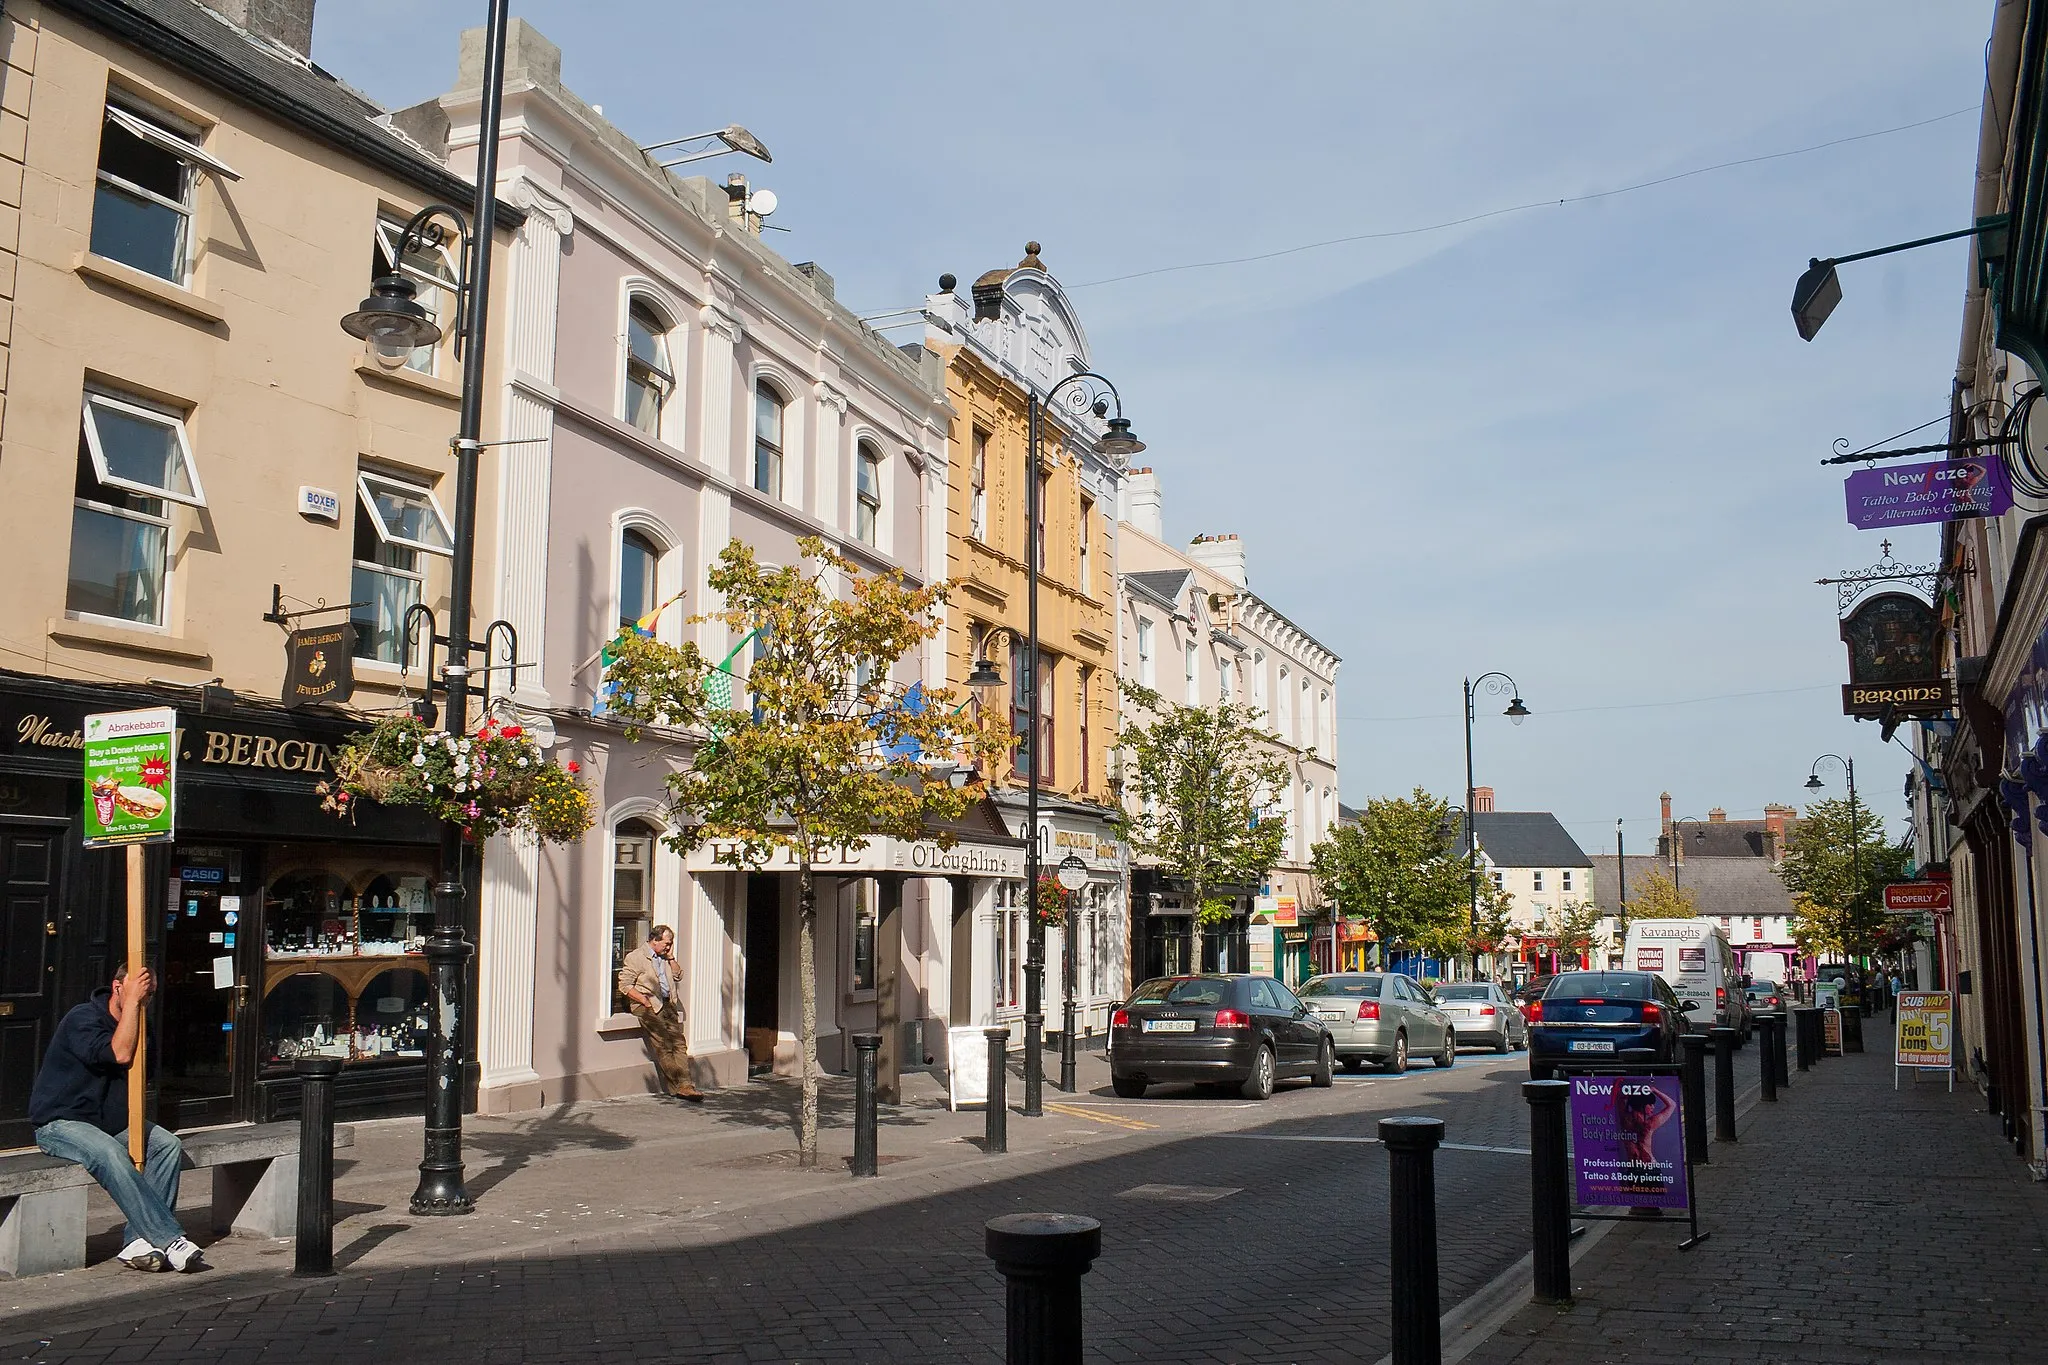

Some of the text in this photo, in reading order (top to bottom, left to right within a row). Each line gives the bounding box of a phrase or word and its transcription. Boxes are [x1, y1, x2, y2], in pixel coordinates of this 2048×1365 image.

[307, 492, 336, 509] BOXER
[1861, 485, 1996, 507] Tattoo Body Piercing
[1879, 506, 1941, 520] Alternative
[1943, 501, 1992, 514] Clothing
[297, 636, 317, 648] JAMES
[296, 680, 337, 696] JEWELLER
[17, 714, 86, 750] Watch
[107, 720, 166, 733] Abrakebabra
[89, 749, 104, 757] Buy
[134, 744, 158, 752] Kebab
[89, 756, 139, 767] Medium Drink
[125, 765, 139, 773] only
[912, 844, 1007, 874] O'Loughlin's
[182, 869, 220, 879] CASIO
[1890, 887, 1932, 896] PROPERTY
[1891, 895, 1933, 903] PROPERLY
[1641, 926, 1701, 941] Kavanaghs
[1638, 949, 1662, 959] CONTRACT
[1638, 959, 1662, 968] CLEANERS
[1901, 995, 1949, 1007] SUBWAY
[1901, 1009, 1922, 1021] ANY
[1902, 1024, 1927, 1036] Foot
[1901, 1037, 1927, 1051] Long
[1899, 1053, 1908, 1061] All
[1908, 1053, 1919, 1063] day
[1920, 1053, 1937, 1063] every
[1582, 1113, 1615, 1125] Tattoo &
[1582, 1128, 1638, 1143] Body Piercing
[1583, 1158, 1673, 1171] Professional Hygienic
[1583, 1171, 1609, 1181] Tattoo
[1640, 1172, 1674, 1184] piercing
[1590, 1185, 1668, 1194] www.new-faze.com
